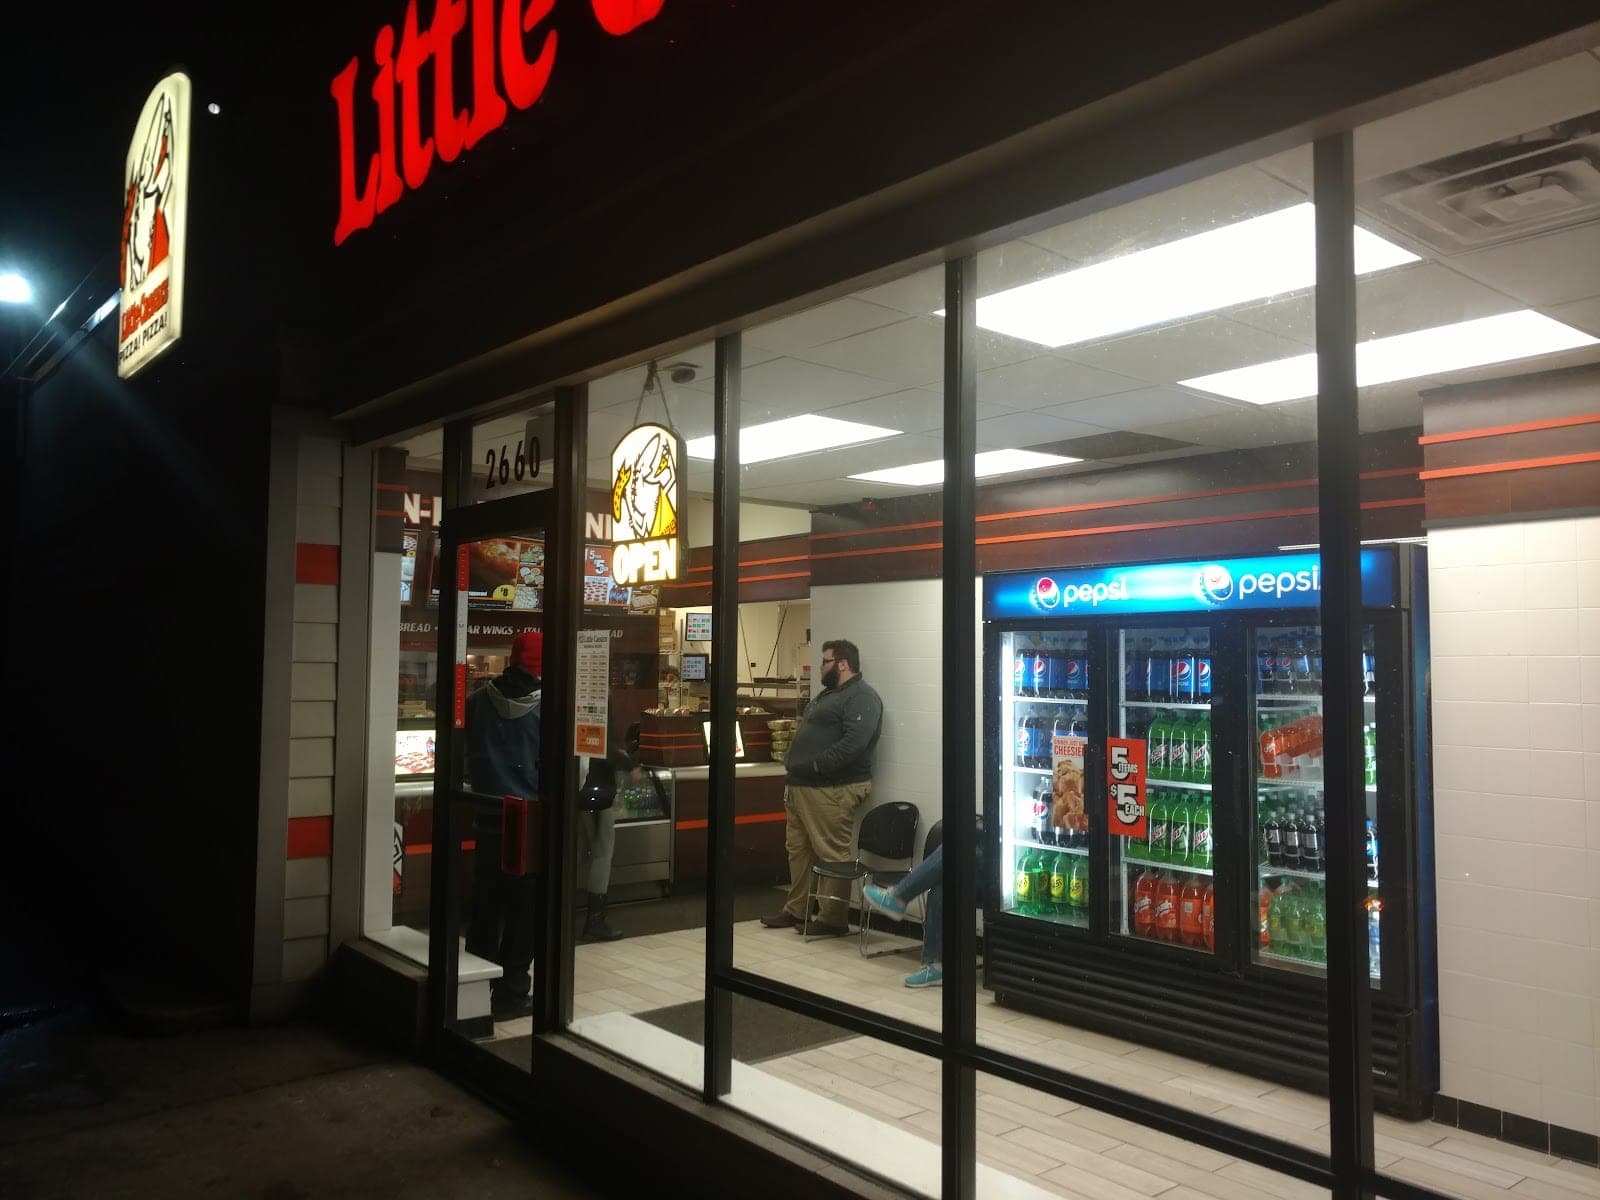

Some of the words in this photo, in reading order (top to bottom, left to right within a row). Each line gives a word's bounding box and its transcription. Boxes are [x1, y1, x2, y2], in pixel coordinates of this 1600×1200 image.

[331, 0, 558, 247] Little
[143, 311, 168, 346] PIZZA!
[485, 436, 541, 489] 2660
[612, 537, 679, 585] OPEN
[1063, 577, 1127, 607] pepsi
[1239, 565, 1320, 600] pepsi
[483, 625, 513, 636] WINGS
[1111, 746, 1130, 780] 5
[1118, 762, 1139, 774] ITEMS
[1125, 803, 1145, 816] EACH
